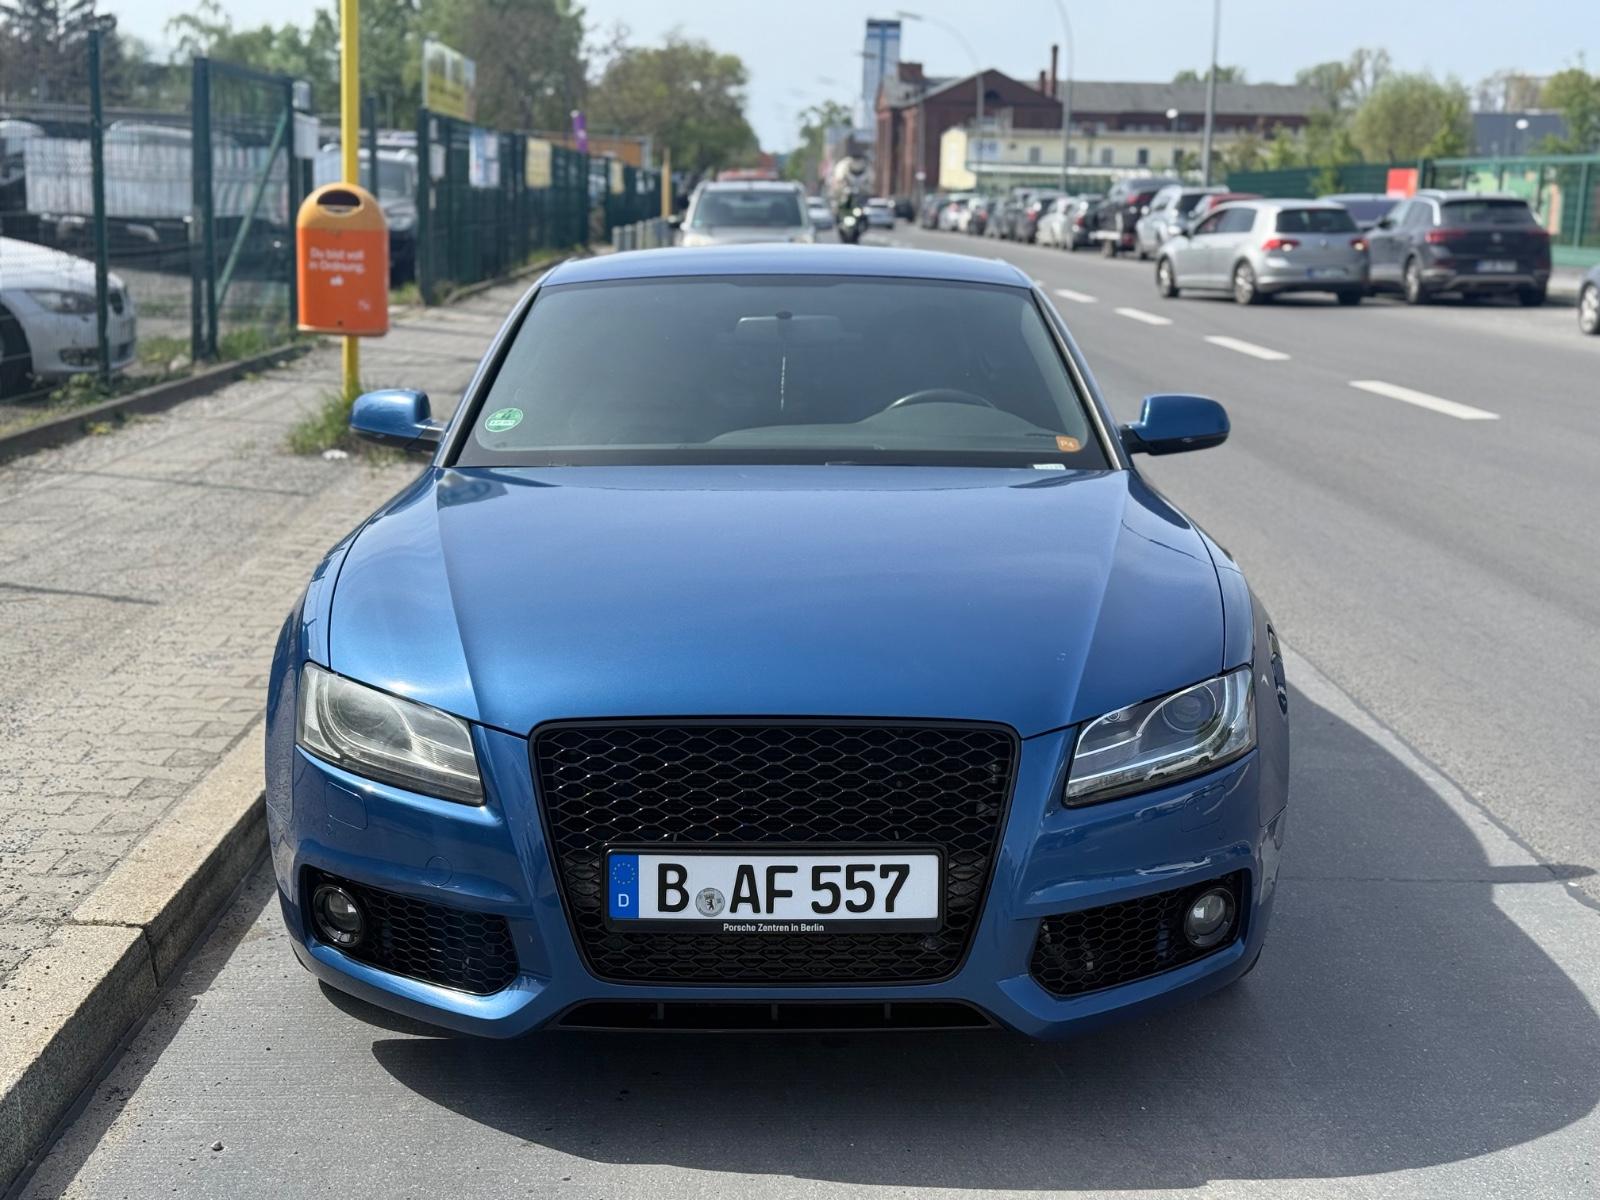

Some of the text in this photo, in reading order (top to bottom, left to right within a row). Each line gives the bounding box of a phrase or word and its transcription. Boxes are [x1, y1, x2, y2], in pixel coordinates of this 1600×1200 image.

[657, 863, 910, 914] B AF 557
[618, 893, 630, 907] D
[723, 923, 756, 932] Porsche
[757, 923, 790, 932] Zentren
[800, 923, 825, 932] Berlin
